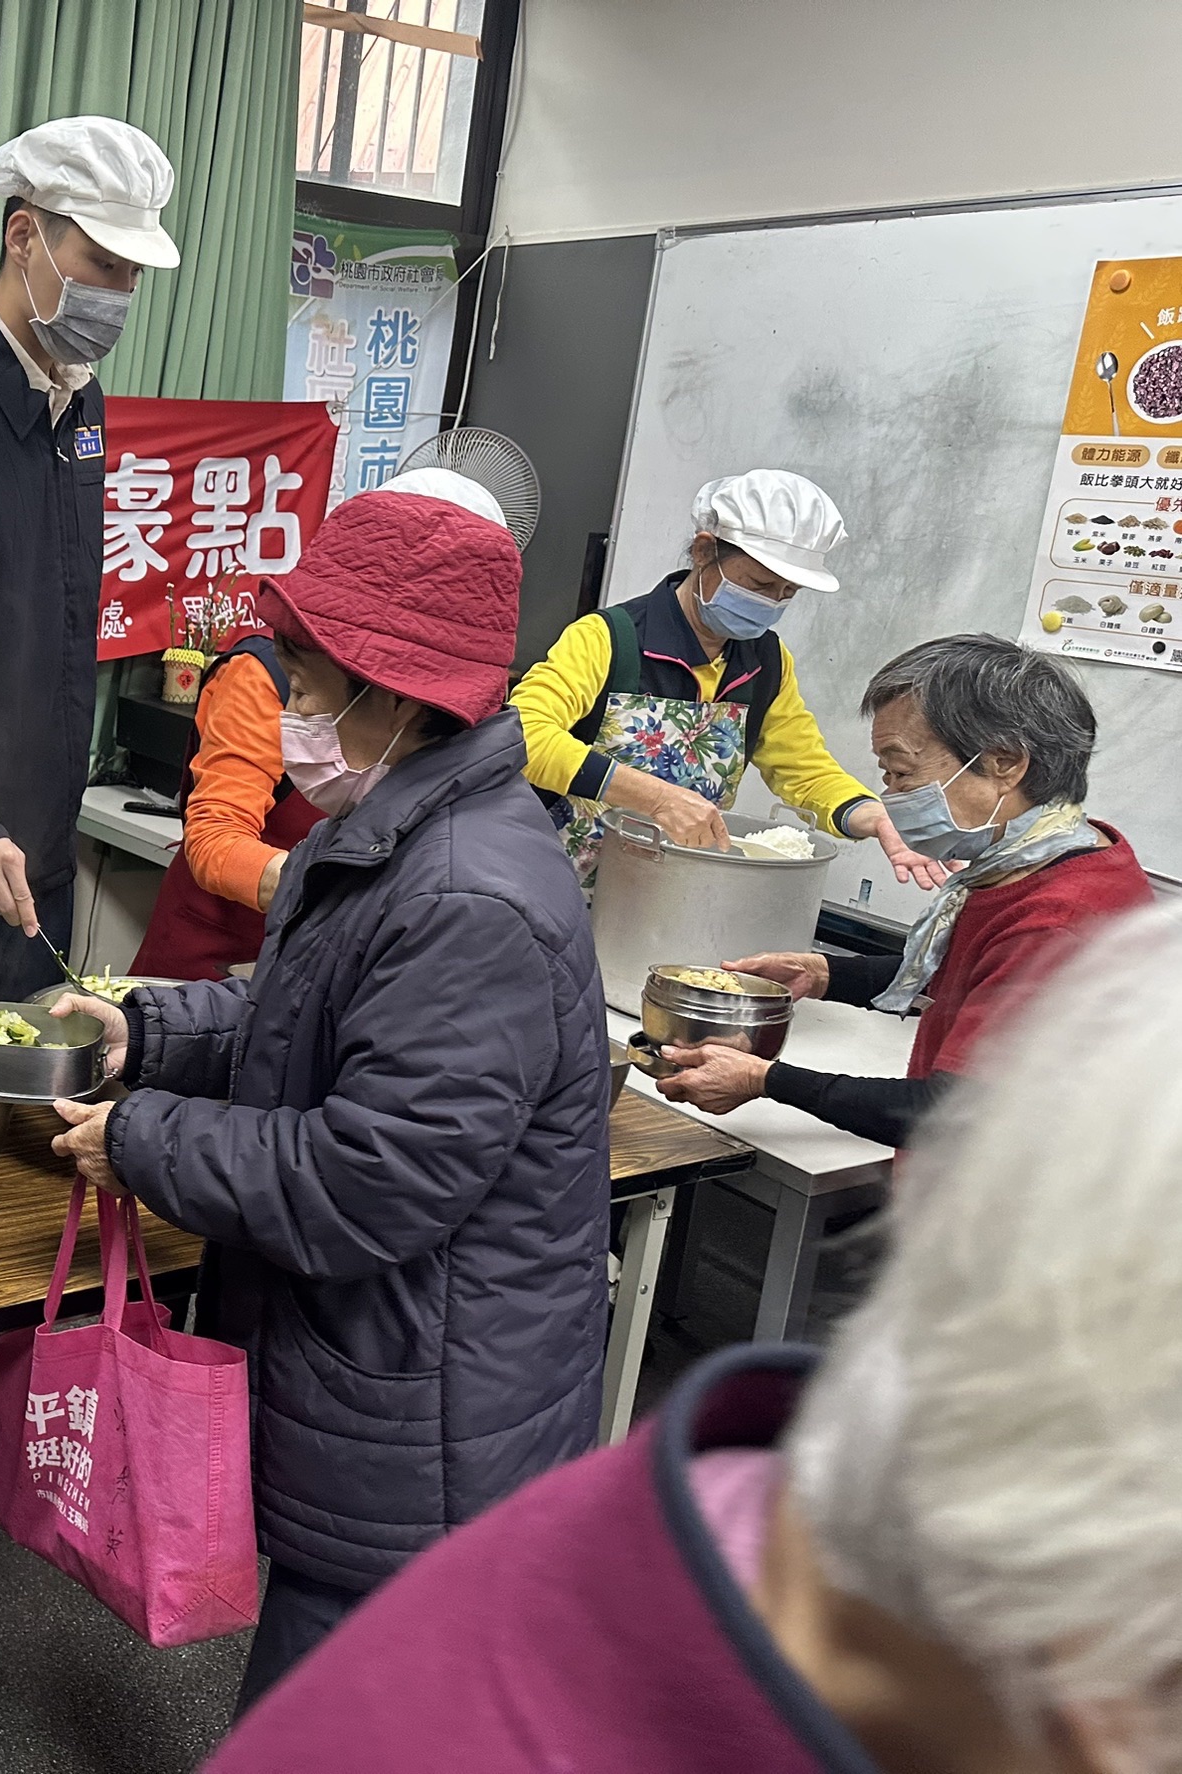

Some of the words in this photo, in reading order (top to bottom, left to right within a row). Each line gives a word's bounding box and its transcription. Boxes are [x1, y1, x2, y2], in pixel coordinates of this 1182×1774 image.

[1081, 447, 1143, 463] 體力能源
[1164, 450, 1182, 464] 纖
[1129, 580, 1182, 600] 僅適量
[24, 1384, 99, 1443] 平鎮
[26, 1435, 93, 1489] 挺好的
[32, 1471, 91, 1512] PINGZHEN
